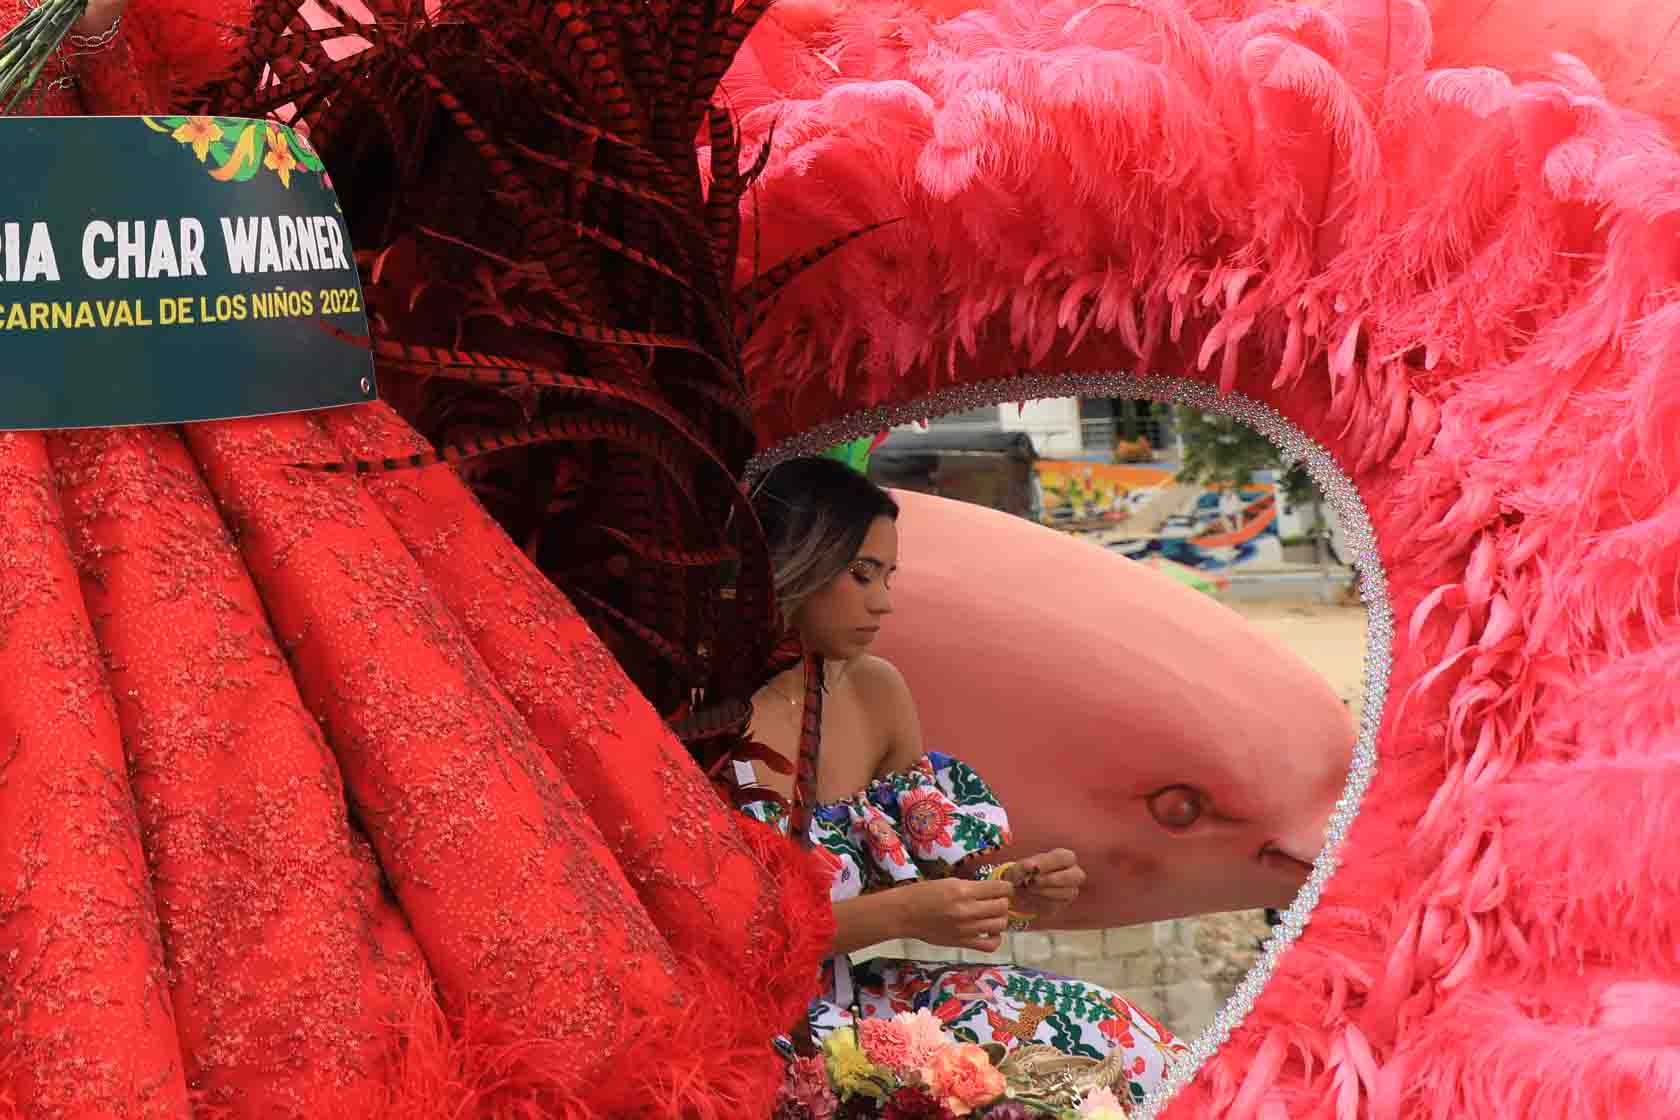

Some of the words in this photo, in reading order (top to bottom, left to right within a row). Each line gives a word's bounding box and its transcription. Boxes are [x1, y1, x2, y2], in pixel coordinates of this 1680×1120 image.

[82, 218, 208, 280] CHAR
[220, 215, 350, 274] WARNER
[159, 297, 195, 325] DE
[200, 295, 246, 324] LOS
[252, 286, 314, 319] NIÑOS
[319, 288, 361, 313] 2022
